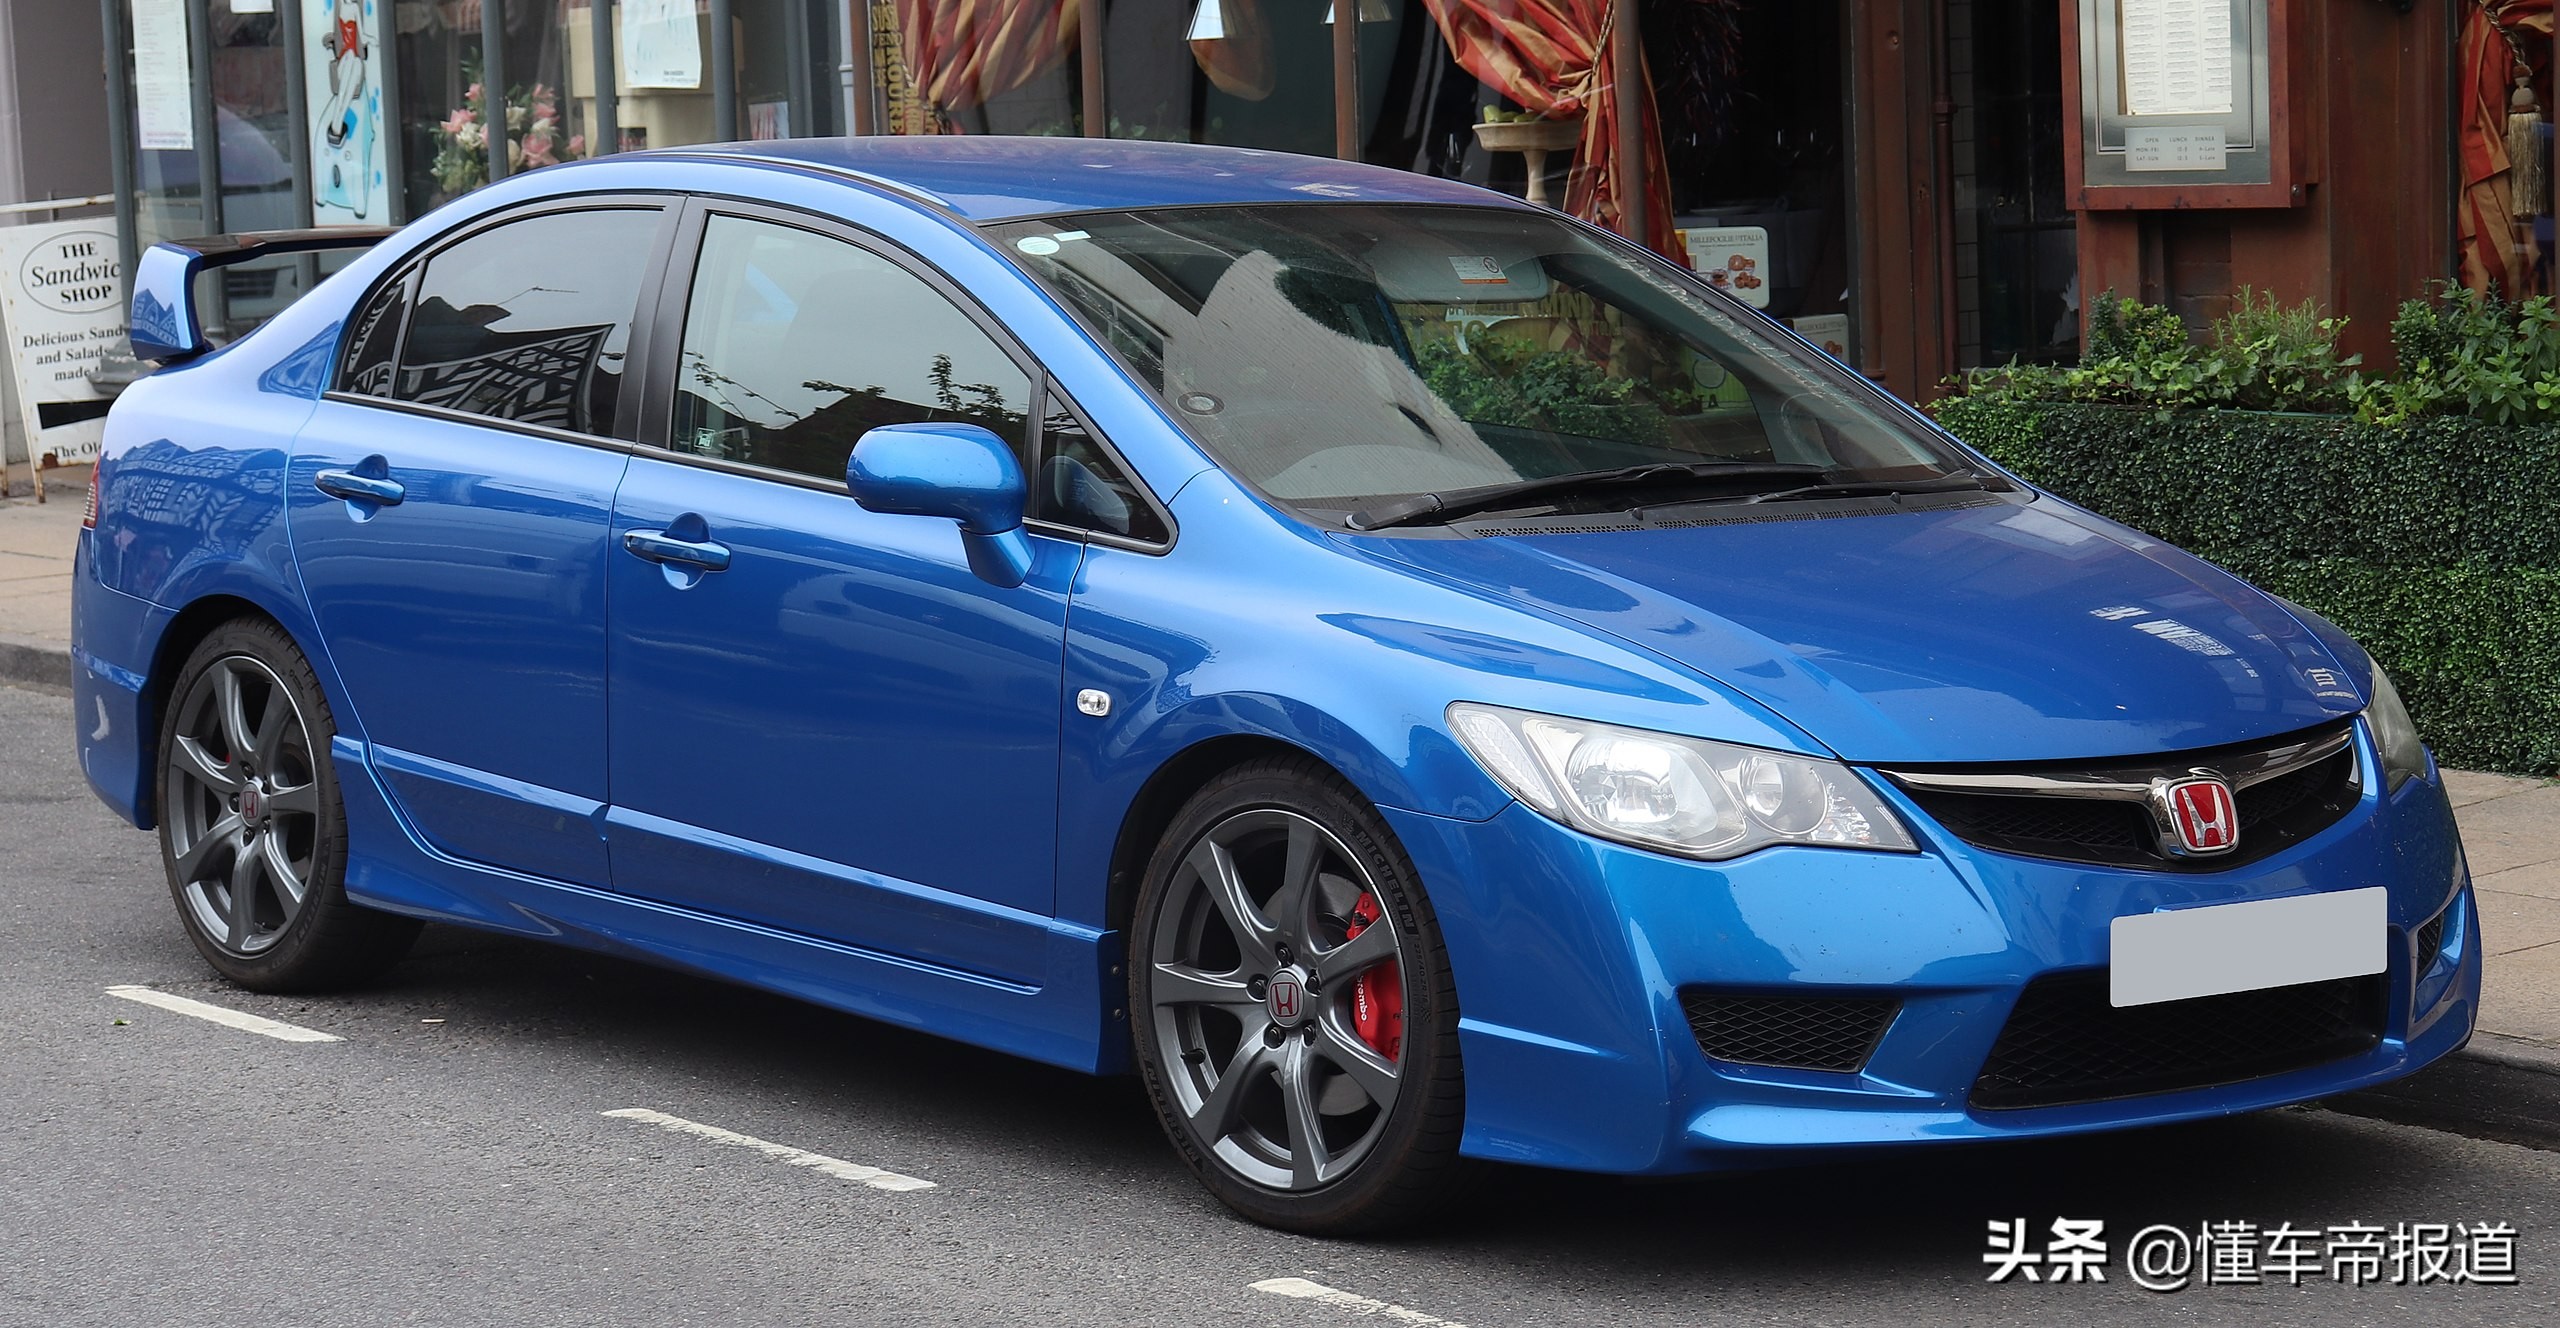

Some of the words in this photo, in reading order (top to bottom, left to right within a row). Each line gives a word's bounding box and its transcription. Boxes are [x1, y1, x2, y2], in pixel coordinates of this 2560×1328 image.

[58, 241, 98, 259] THE
[31, 258, 121, 288] Sandwic
[60, 284, 112, 304] SHOP
[23, 331, 85, 349] Delicious
[89, 324, 125, 341] Sand
[36, 350, 61, 366] and
[54, 366, 91, 382] made
[51, 444, 77, 459] The
[81, 441, 101, 455] Ol
[1356, 830, 1416, 929] MICHELIN
